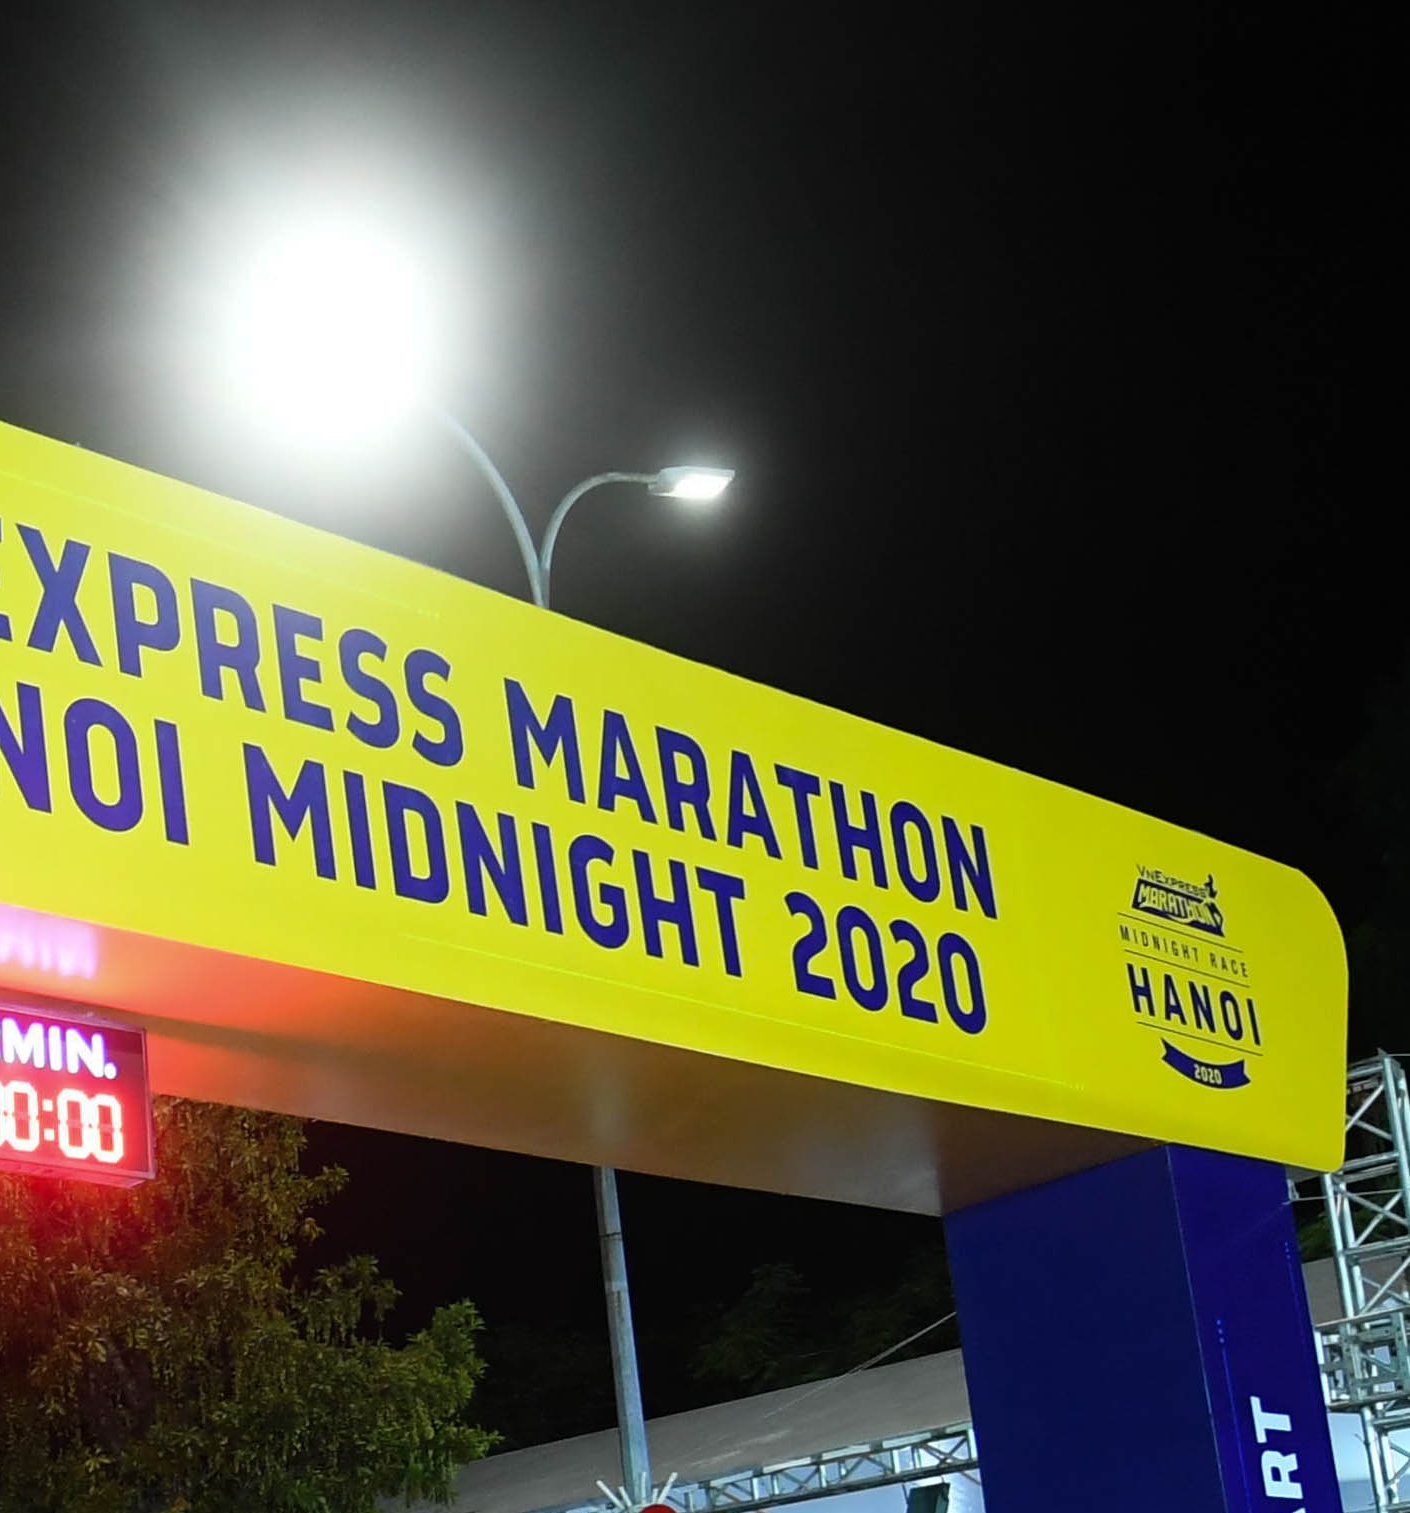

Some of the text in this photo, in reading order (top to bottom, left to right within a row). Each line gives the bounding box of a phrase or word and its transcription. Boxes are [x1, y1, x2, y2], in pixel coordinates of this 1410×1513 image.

[504, 677, 998, 920] MARATHON
[242, 742, 745, 978] MIDNIGHT
[785, 890, 988, 1036] 2020
[1119, 924, 1249, 978] MIDNIGHT RACE
[1126, 962, 1262, 1047] HANOI
[1193, 1063, 1223, 1086] 2020
